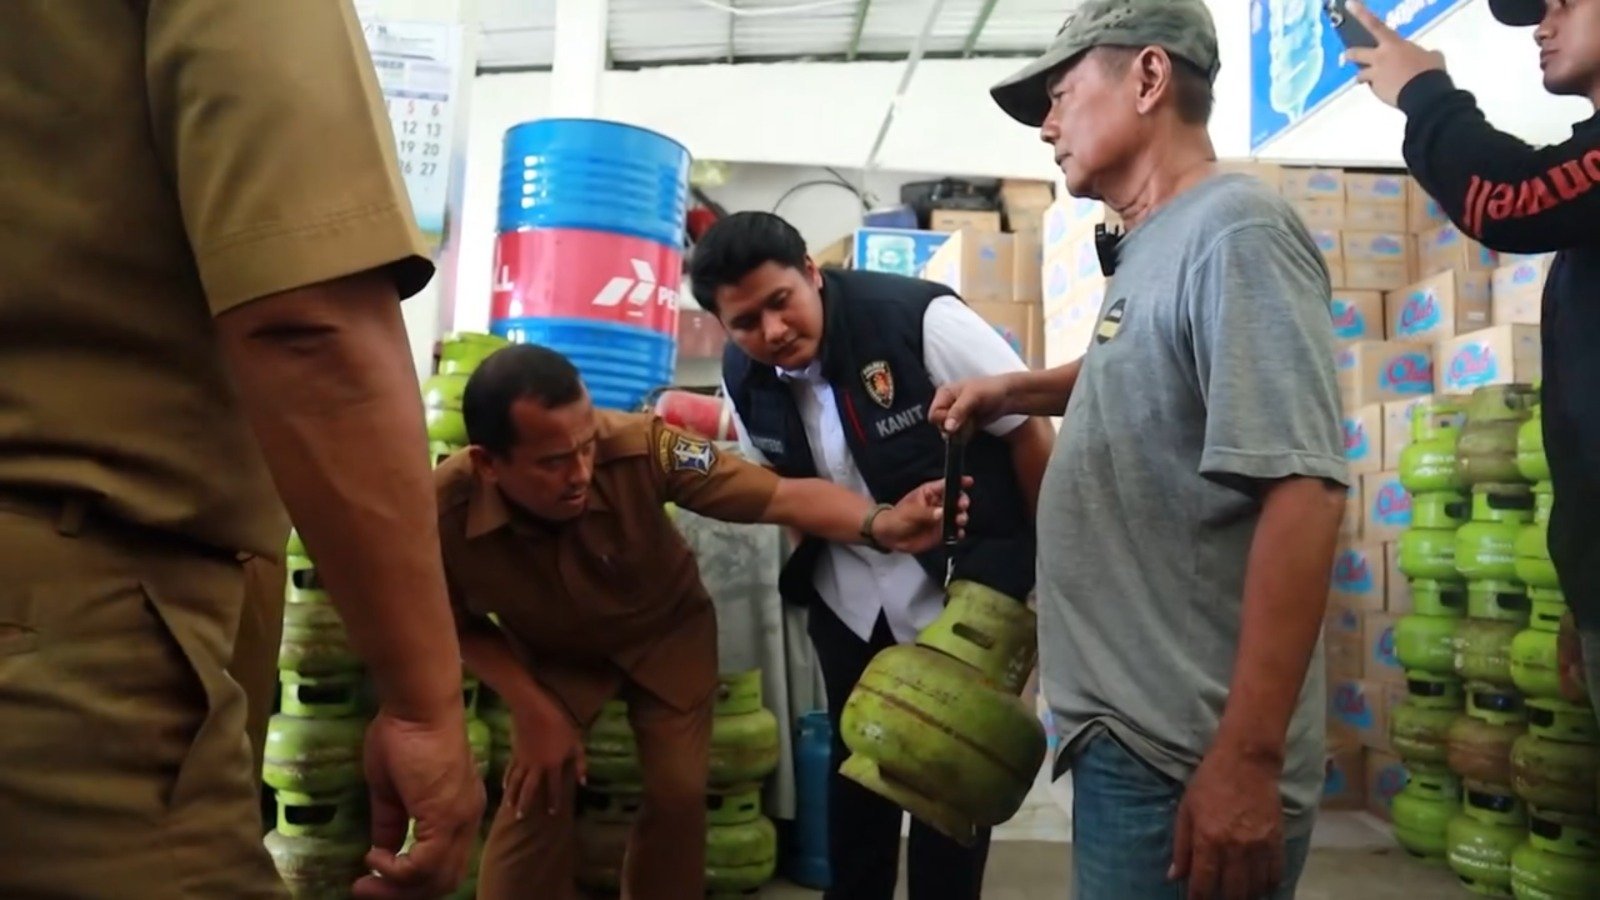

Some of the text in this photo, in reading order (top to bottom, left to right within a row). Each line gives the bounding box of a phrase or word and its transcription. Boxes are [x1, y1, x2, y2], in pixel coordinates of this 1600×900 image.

[403, 121, 441, 137] 12 13
[422, 142, 439, 157] 20
[420, 162, 437, 176] 27
[876, 405, 923, 437] KANIT
